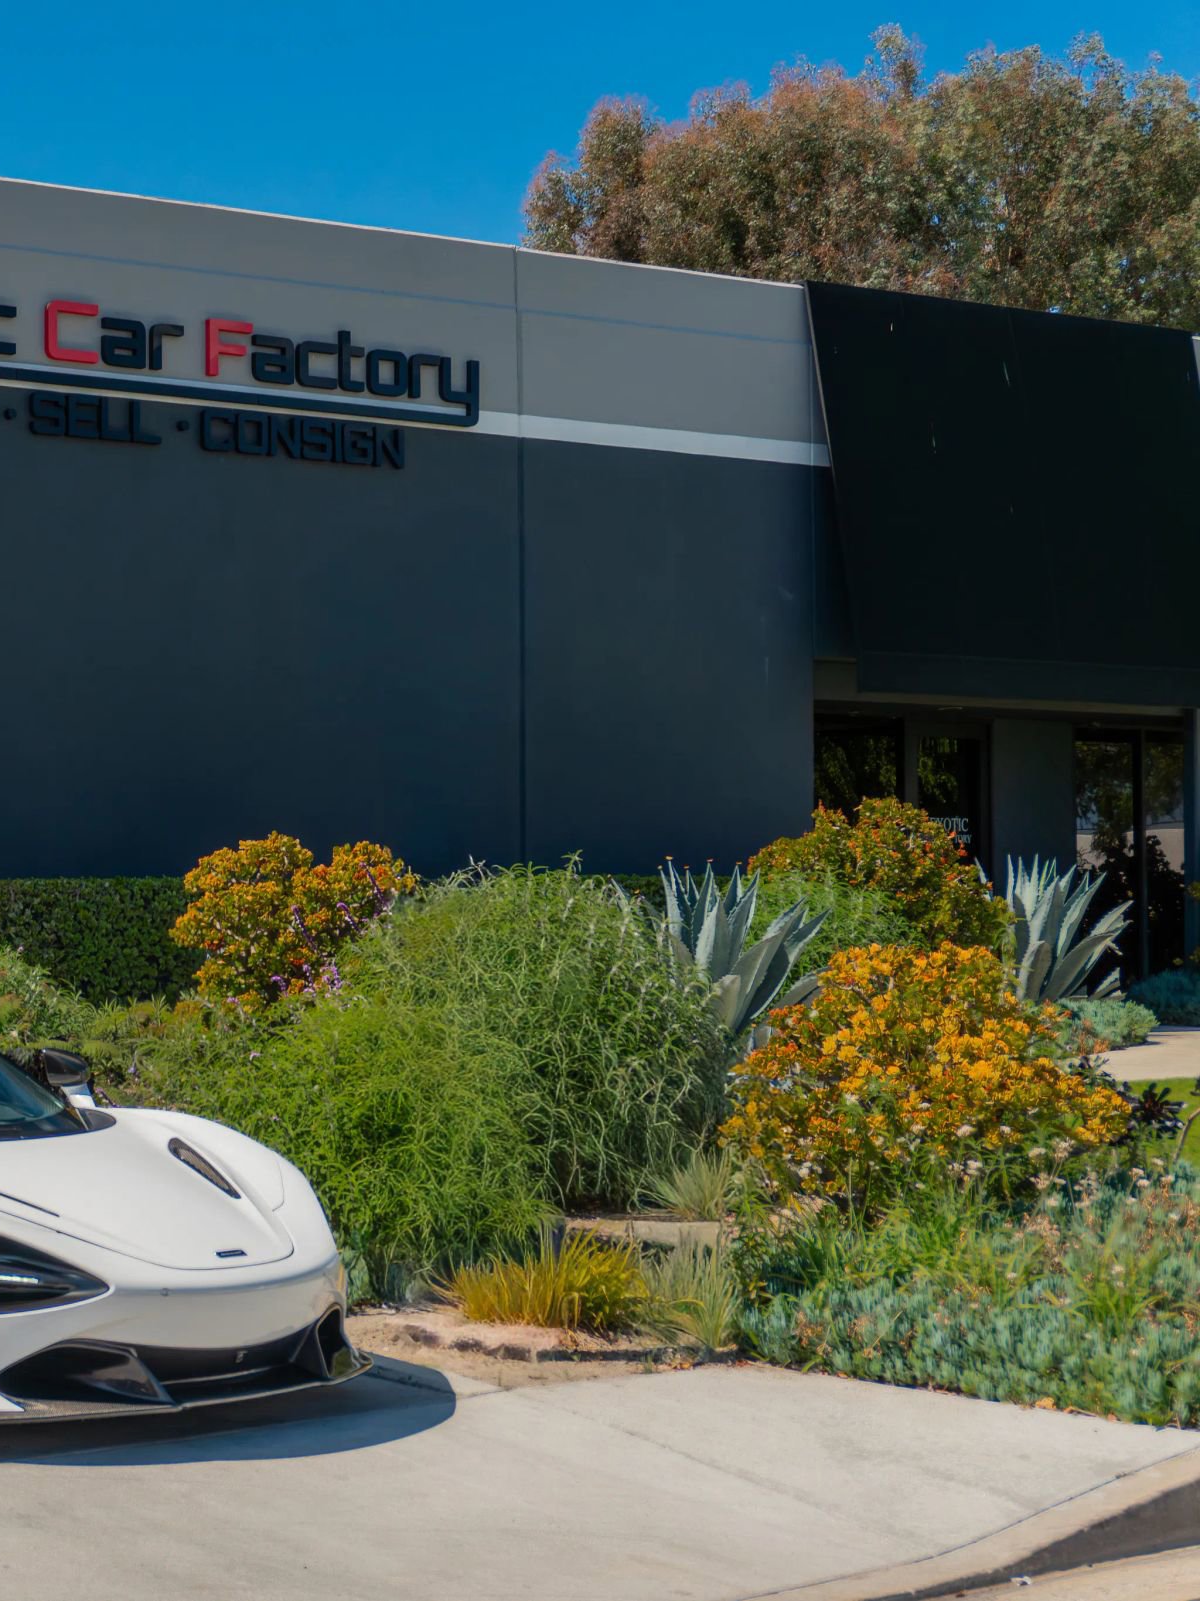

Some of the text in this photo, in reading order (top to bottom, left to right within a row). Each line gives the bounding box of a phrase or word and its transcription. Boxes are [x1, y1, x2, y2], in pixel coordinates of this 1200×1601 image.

[44, 300, 184, 371] Car
[205, 318, 480, 427] Factory
[29, 390, 162, 445] SELL
[199, 408, 405, 469] CONSIGN
